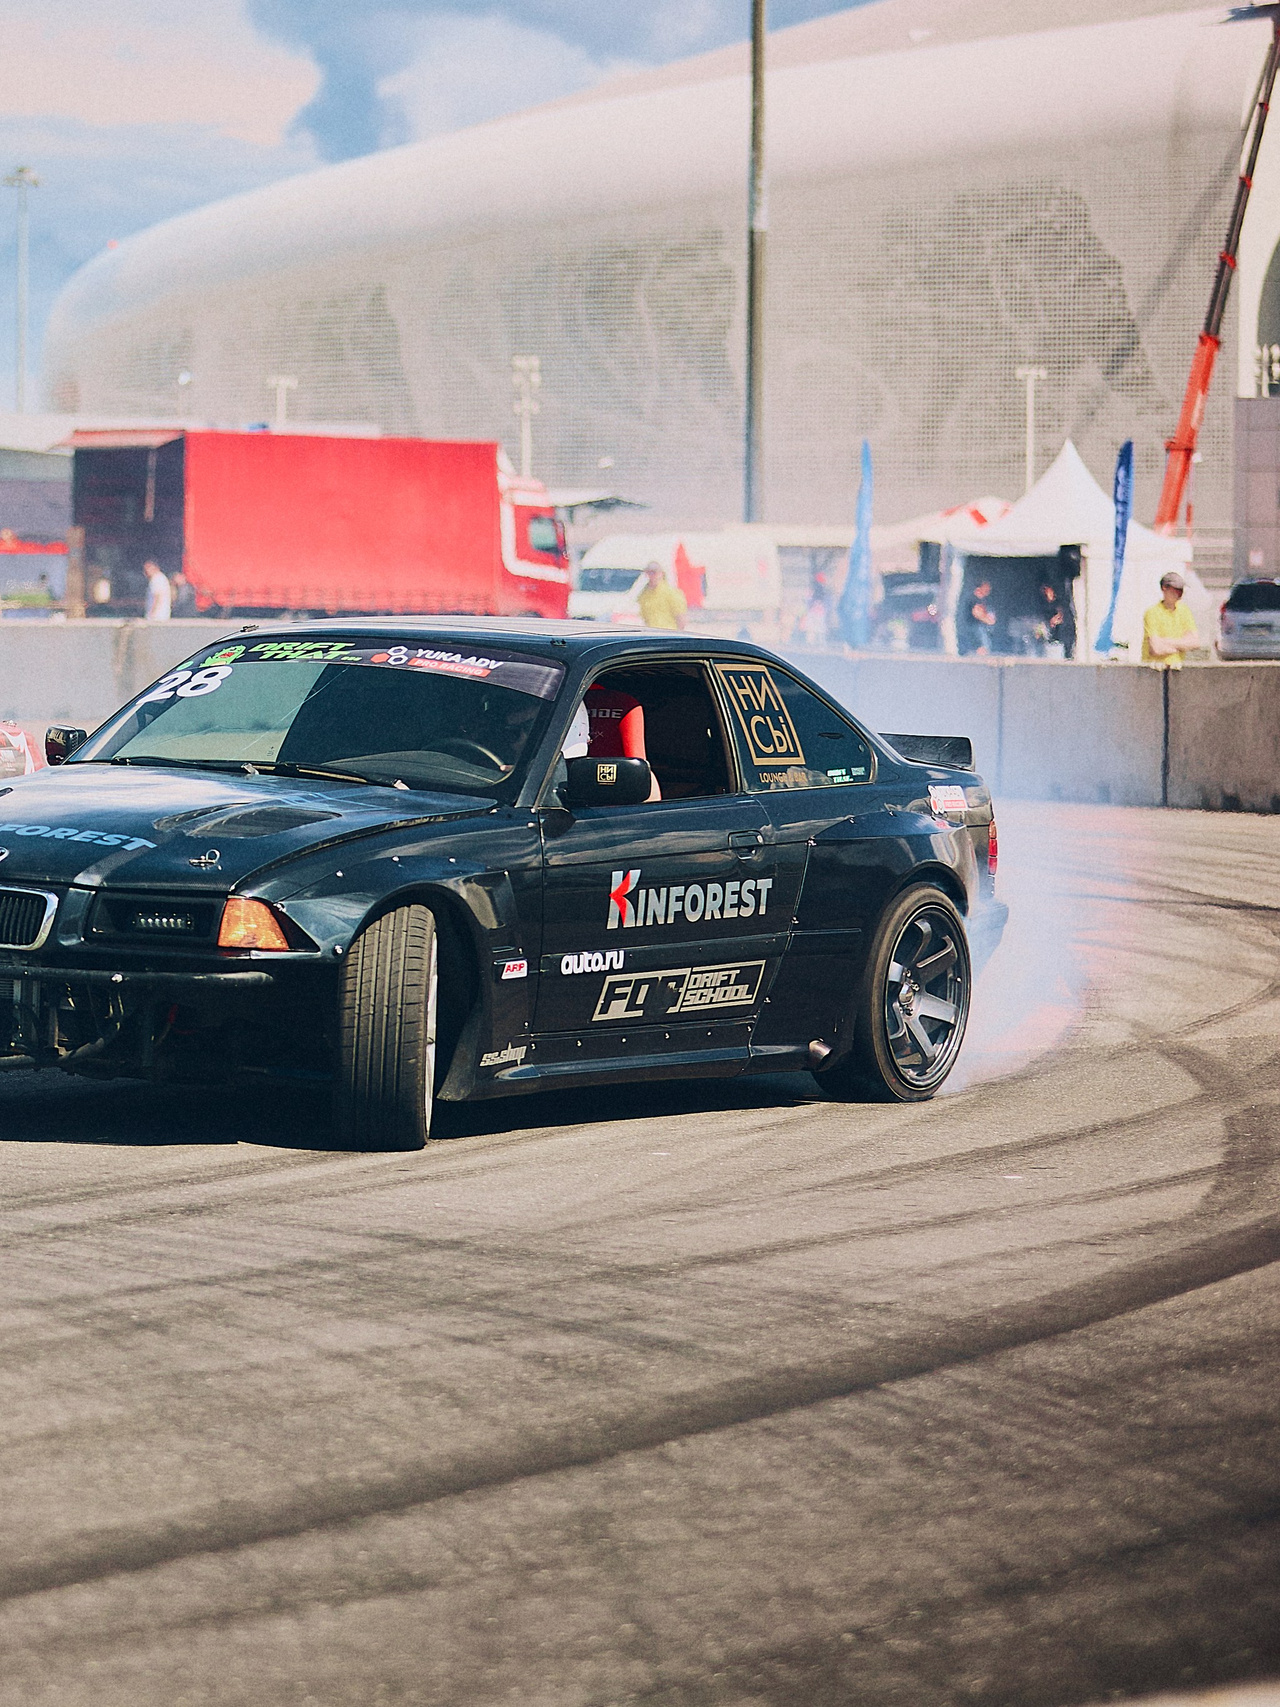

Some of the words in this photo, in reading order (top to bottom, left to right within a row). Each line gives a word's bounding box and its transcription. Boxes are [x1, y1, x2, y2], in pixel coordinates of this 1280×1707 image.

[248, 642, 356, 652] DRIFT
[414, 660, 438, 668] PRO
[439, 663, 483, 675] RACING
[135, 666, 233, 706] 28
[728, 675, 780, 711] НИ
[606, 869, 773, 930] KINFOREST
[505, 963, 525, 973] ARP
[561, 950, 625, 975] auto.ru
[687, 969, 741, 989] DRIFT
[682, 984, 754, 1006] SCHOOL
